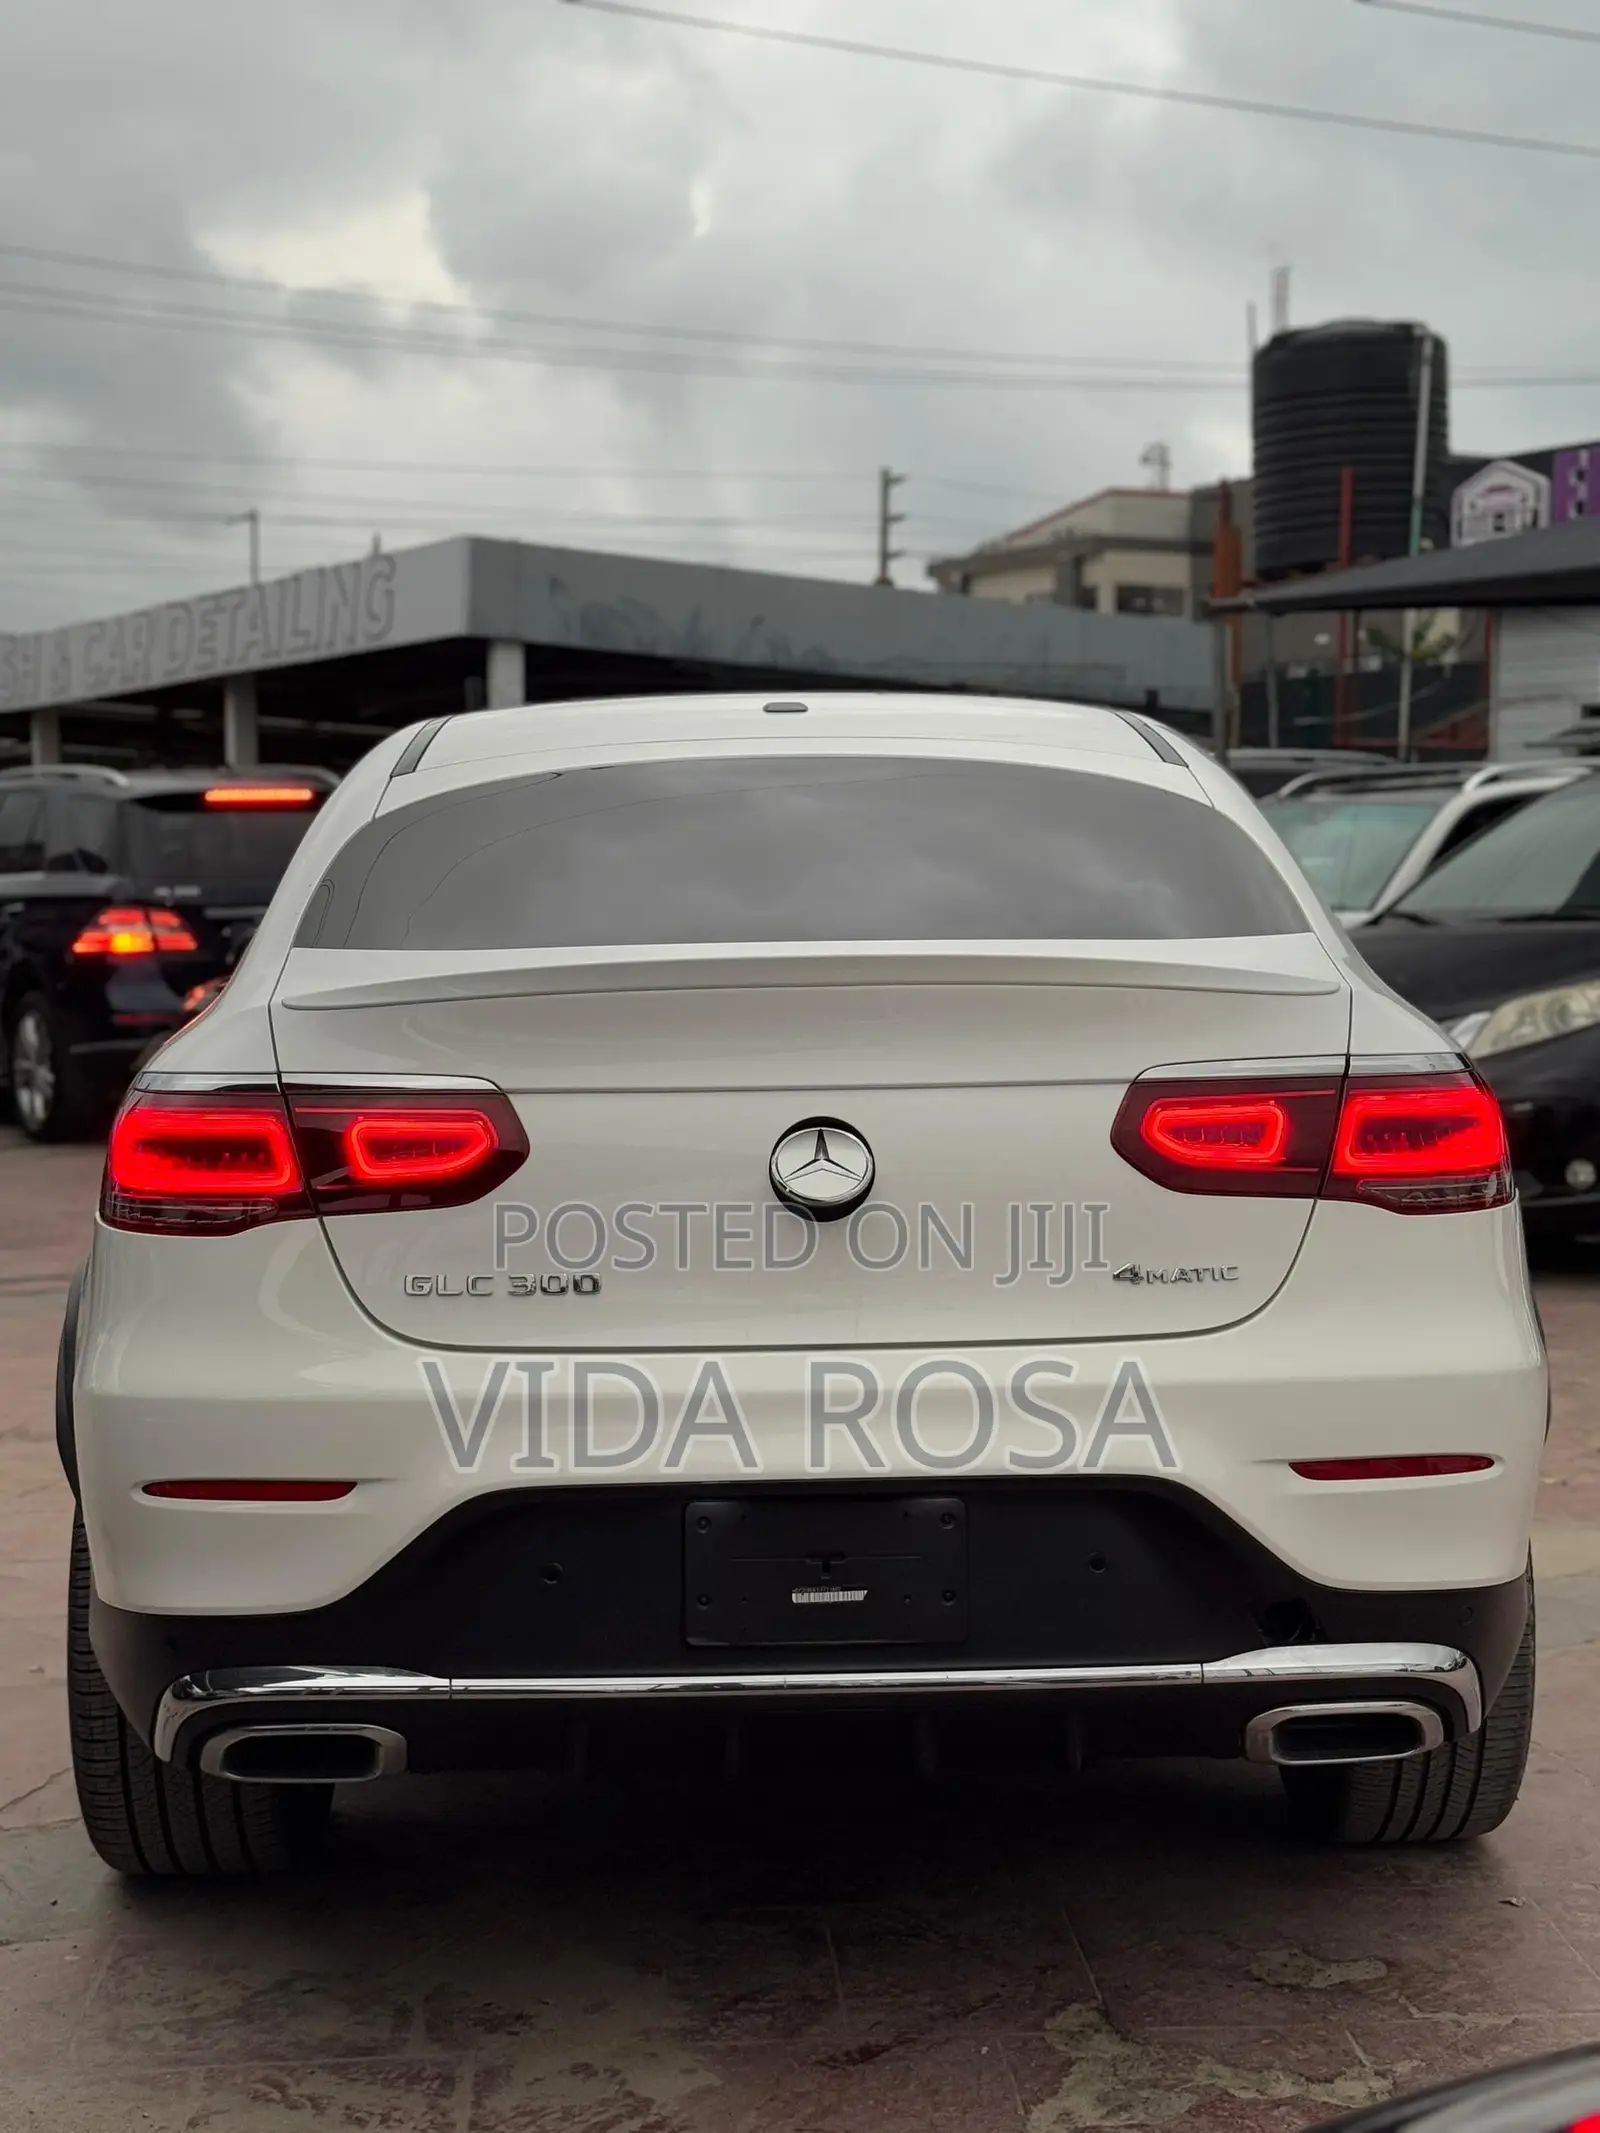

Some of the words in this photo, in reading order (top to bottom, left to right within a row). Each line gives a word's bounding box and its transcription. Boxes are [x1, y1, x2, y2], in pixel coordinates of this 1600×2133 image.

[83, 611, 154, 687] CAR
[163, 554, 397, 677] DETAILING
[404, 1274, 494, 1296] GLC
[507, 1272, 602, 1296] 300
[1112, 1261, 1240, 1286] 4MATIC
